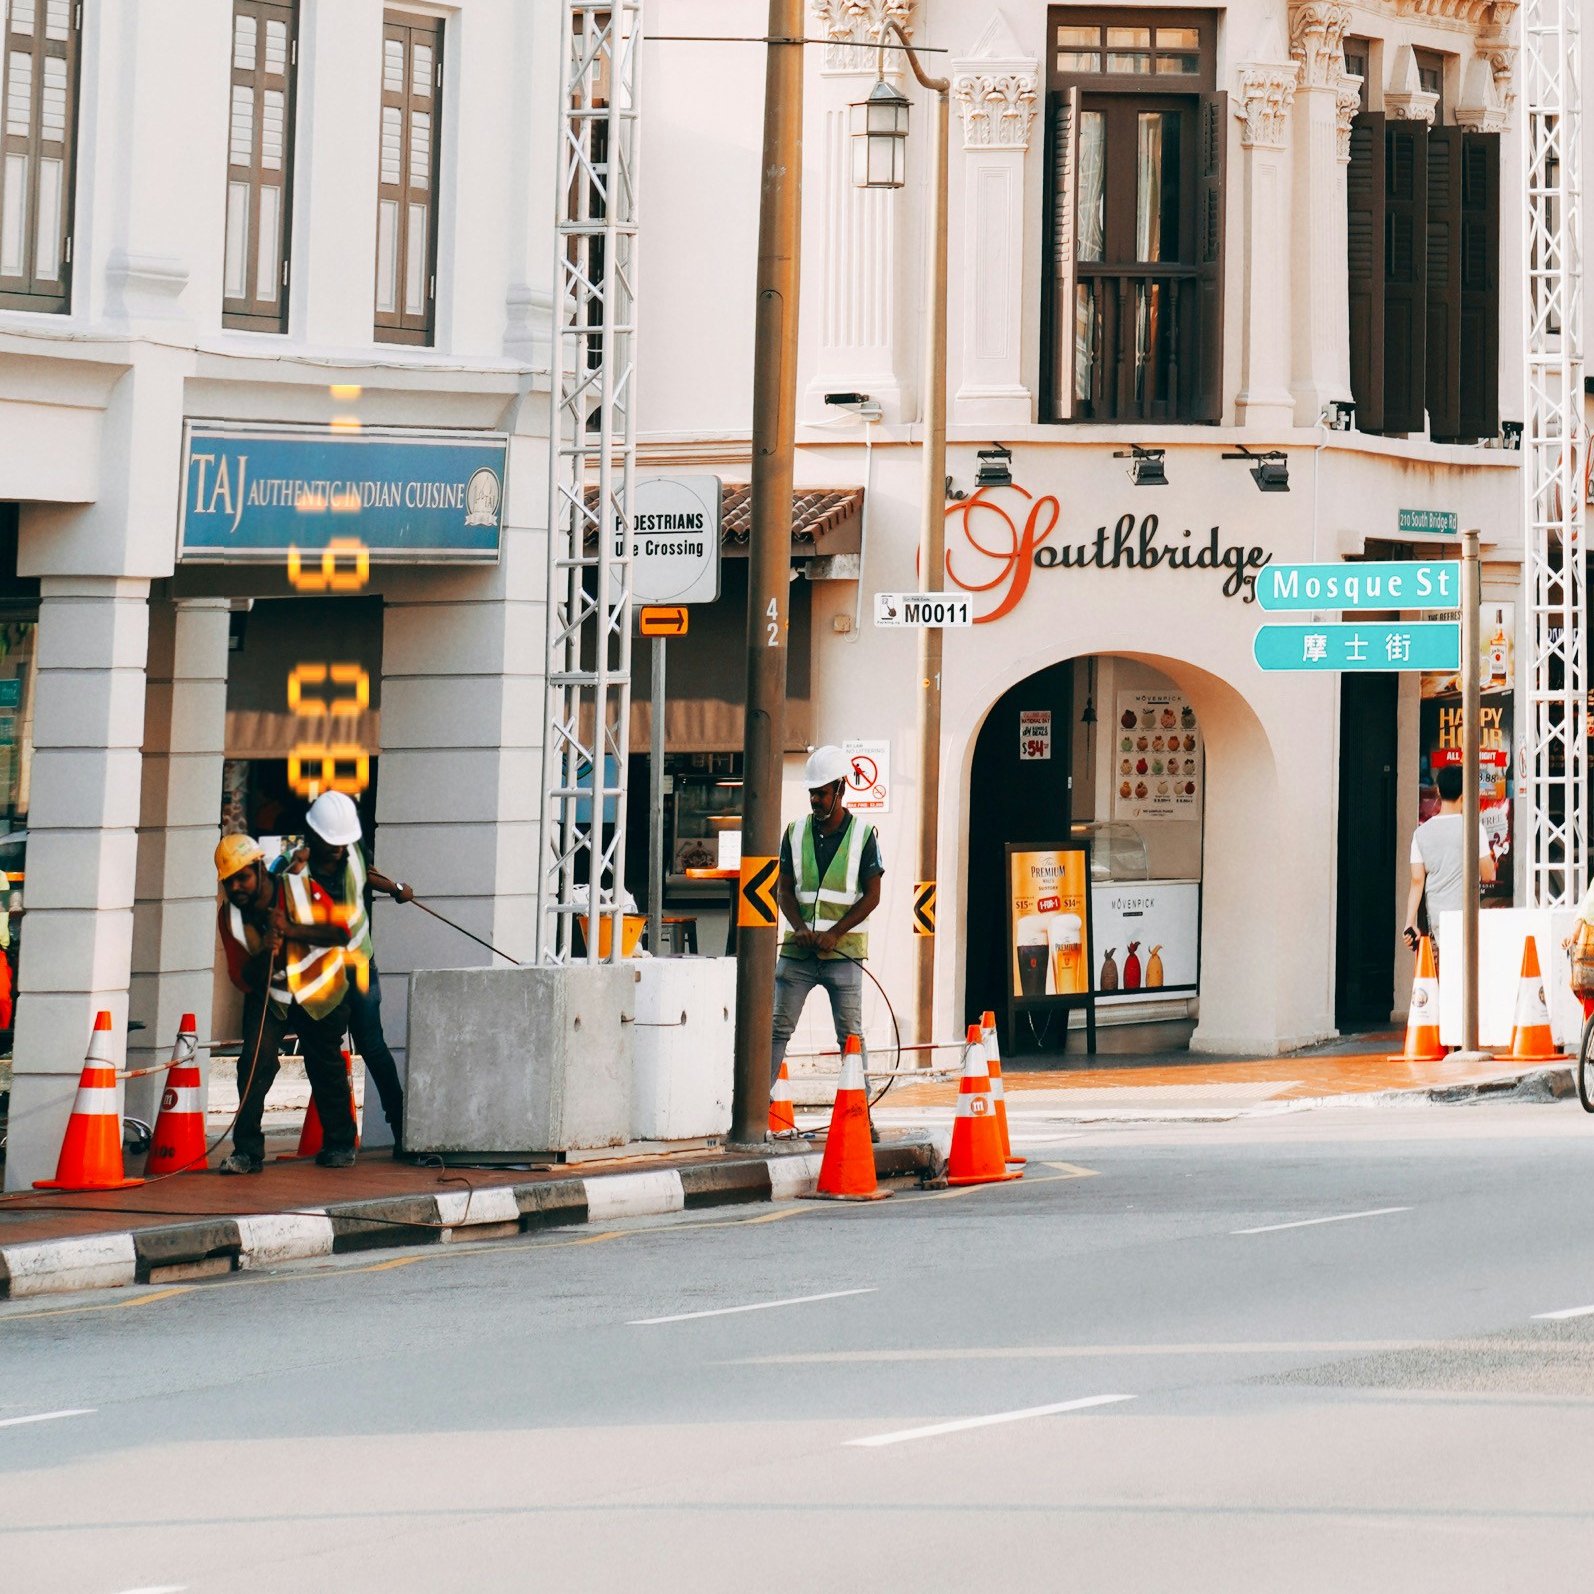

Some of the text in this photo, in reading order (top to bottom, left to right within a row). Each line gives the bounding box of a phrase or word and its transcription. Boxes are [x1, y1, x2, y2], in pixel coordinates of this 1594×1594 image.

[190, 453, 465, 534] TAJ AUTHENTIC INDIAN CUISINE
[945, 476, 968, 500] he
[615, 513, 704, 531] PDESTRIANS
[1400, 511, 1457, 533] 210 South Bridge Rd
[615, 539, 704, 558] Ue Crossing
[917, 483, 1273, 624] Southbridge
[1273, 569, 1403, 605] Mosque
[1416, 567, 1450, 597] St
[766, 598, 779, 647] 42
[905, 603, 967, 623] M0011
[1302, 633, 1412, 662] 摩士街
[1439, 707, 1503, 729] HAPY
[1446, 751, 1460, 761] ALL
[1031, 865, 1066, 878] PREMIUM
